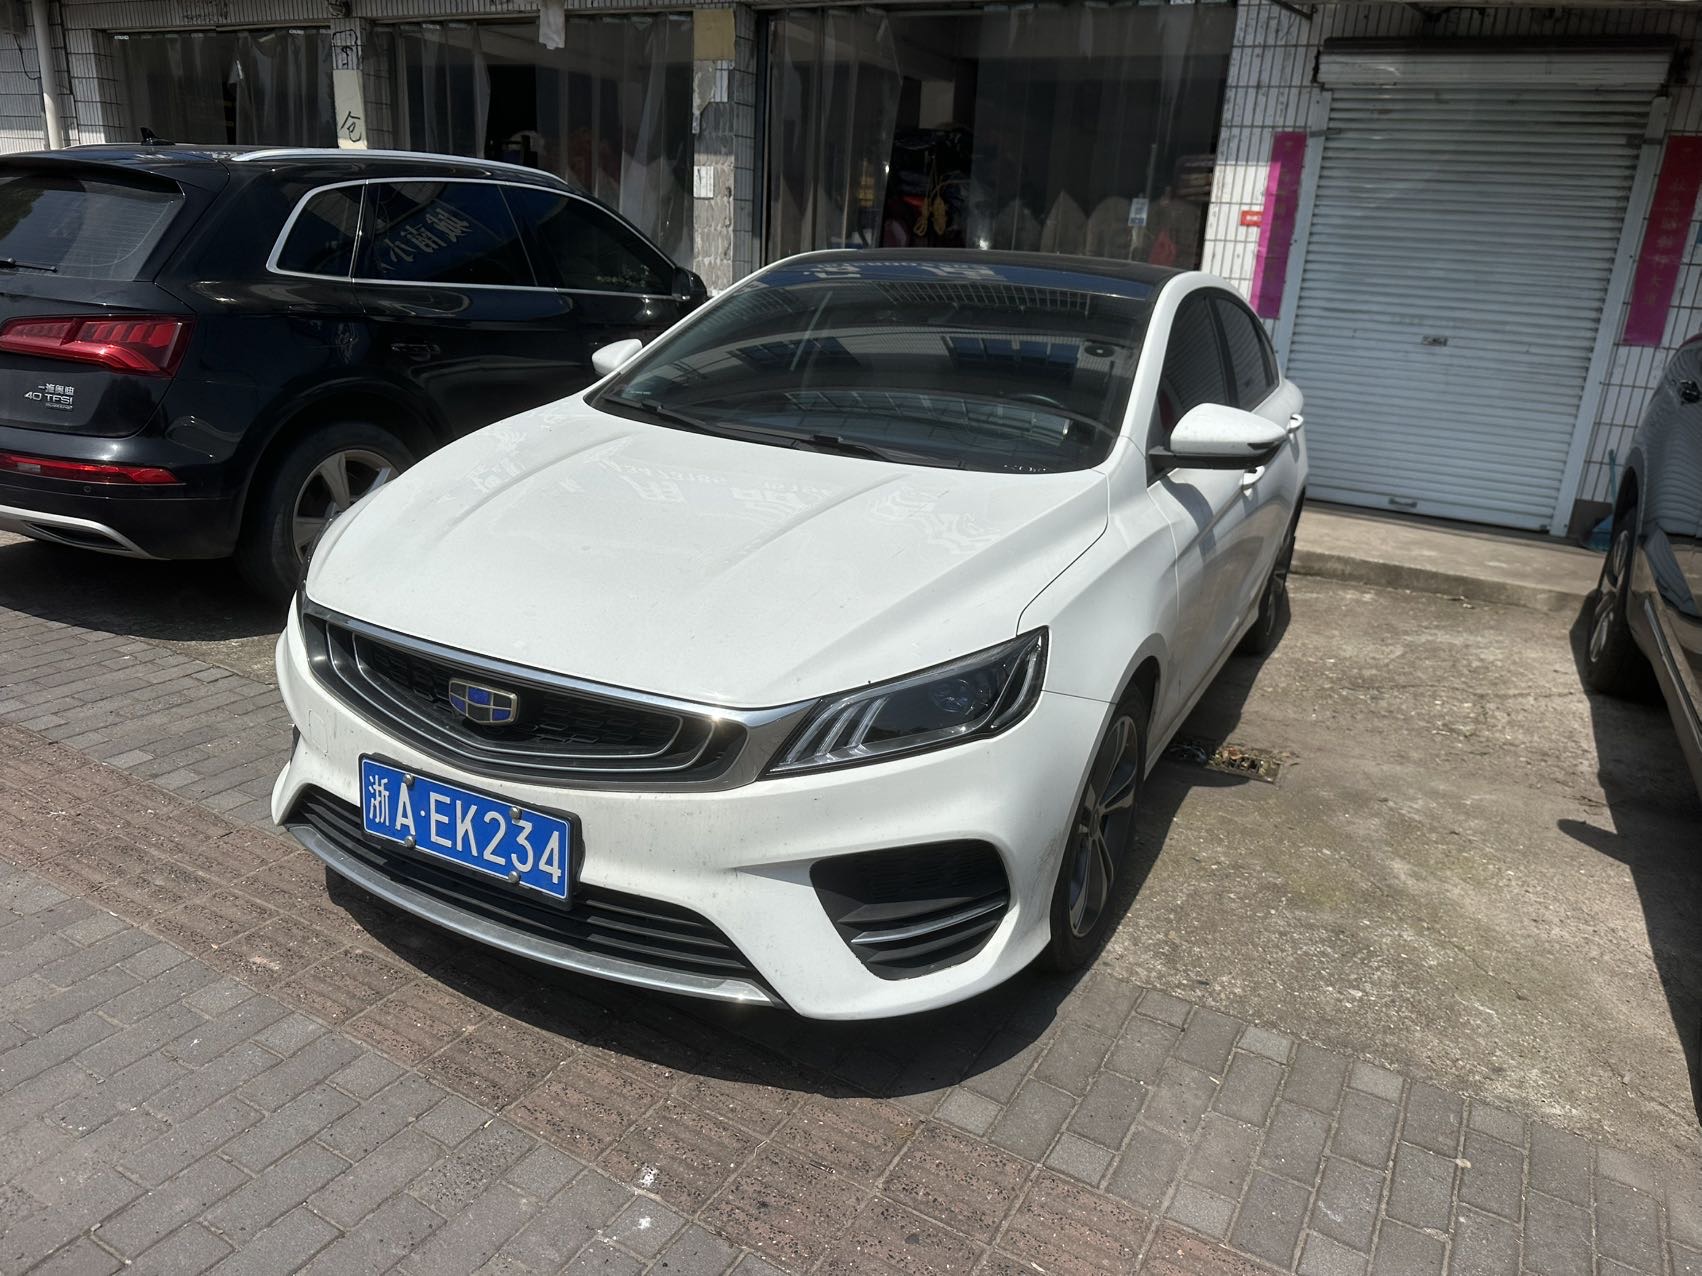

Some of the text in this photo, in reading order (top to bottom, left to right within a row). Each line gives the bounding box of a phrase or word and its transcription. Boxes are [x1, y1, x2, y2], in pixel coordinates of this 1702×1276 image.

[37, 383, 75, 396] 一汽奥迪
[24, 391, 73, 405] 40 TFSI
[368, 774, 562, 885] 浙A·EK234
